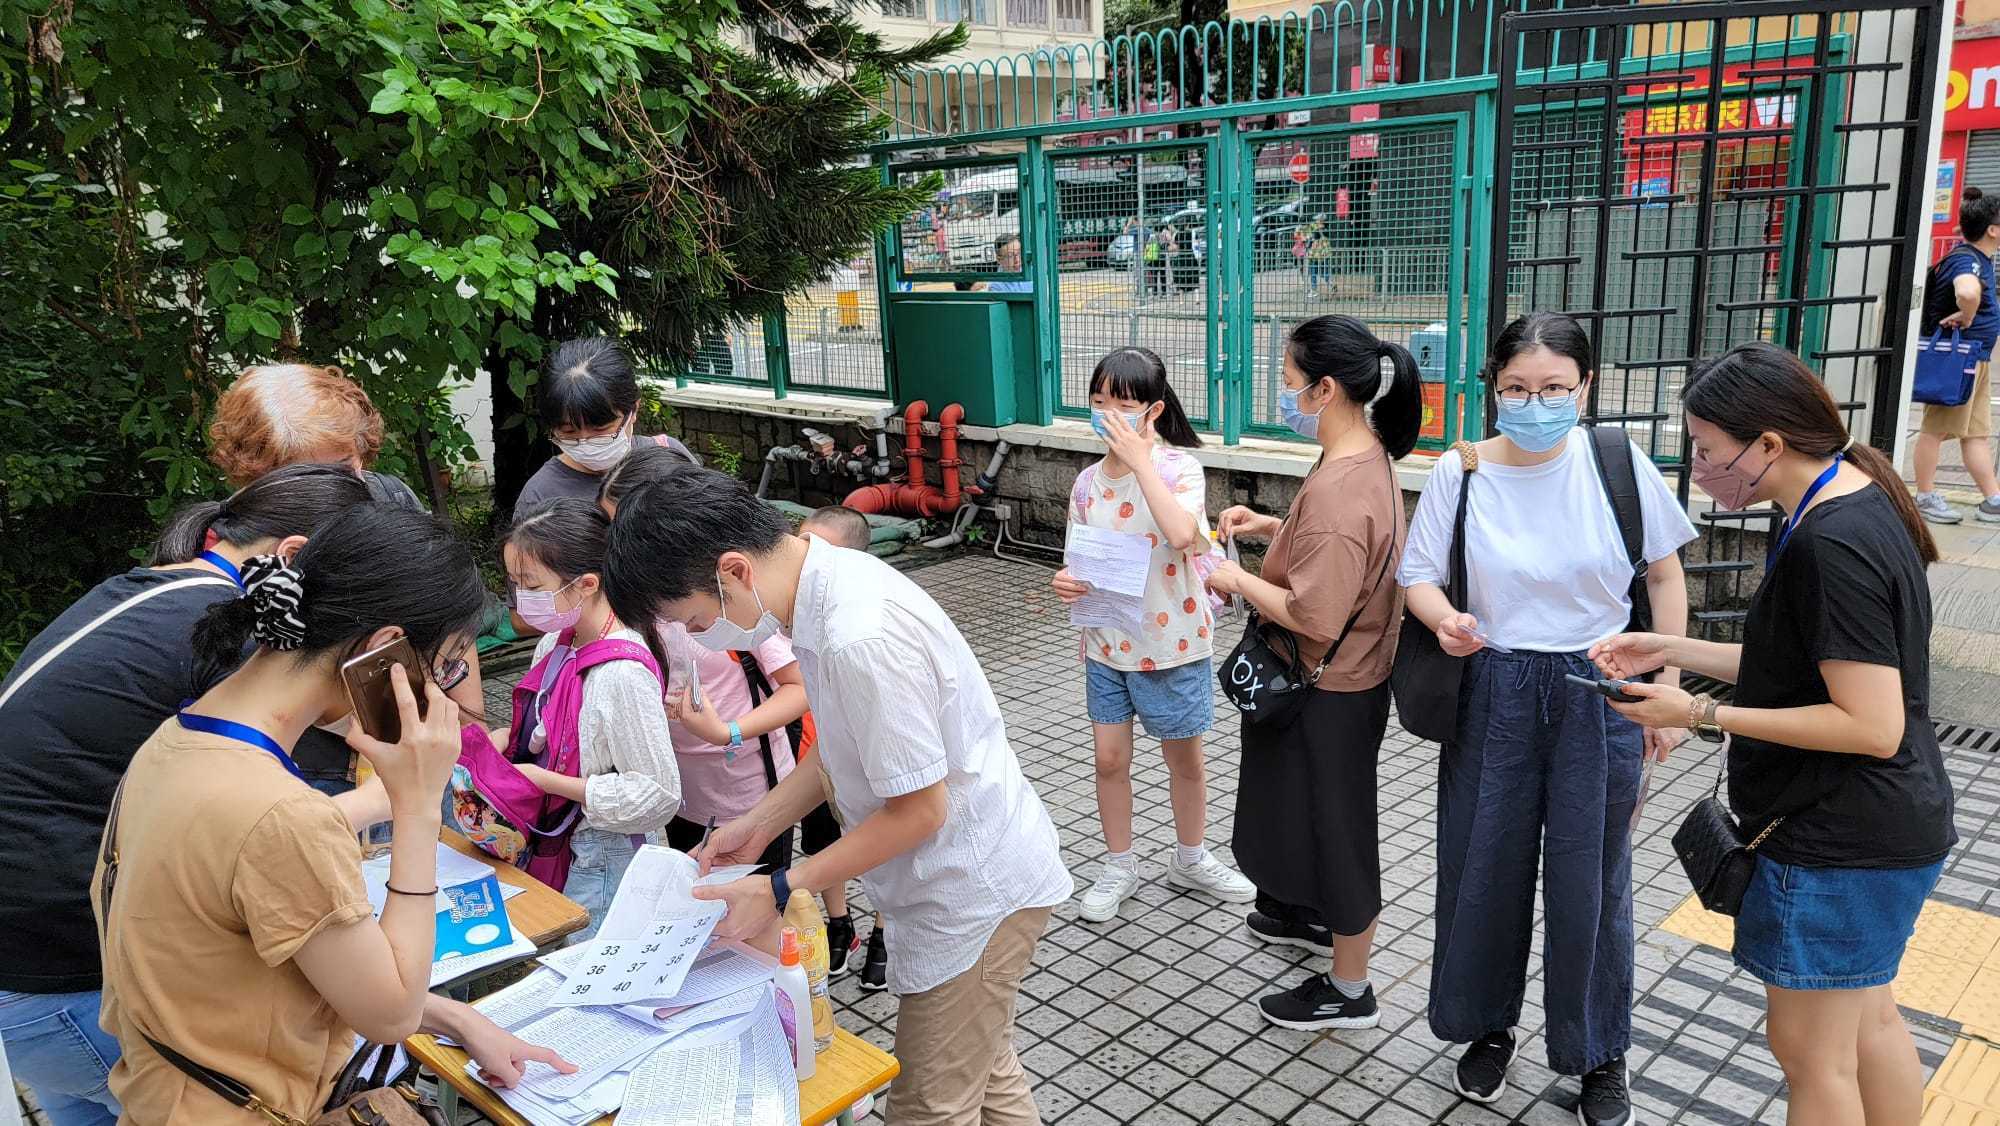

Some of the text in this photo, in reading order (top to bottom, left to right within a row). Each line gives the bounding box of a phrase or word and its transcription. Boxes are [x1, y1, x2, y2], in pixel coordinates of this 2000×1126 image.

[655, 925, 674, 935] 31
[601, 935, 698, 956] 33 34 35
[587, 965, 606, 975] 36
[627, 962, 648, 973] 37
[571, 974, 668, 995] 39 40 N
